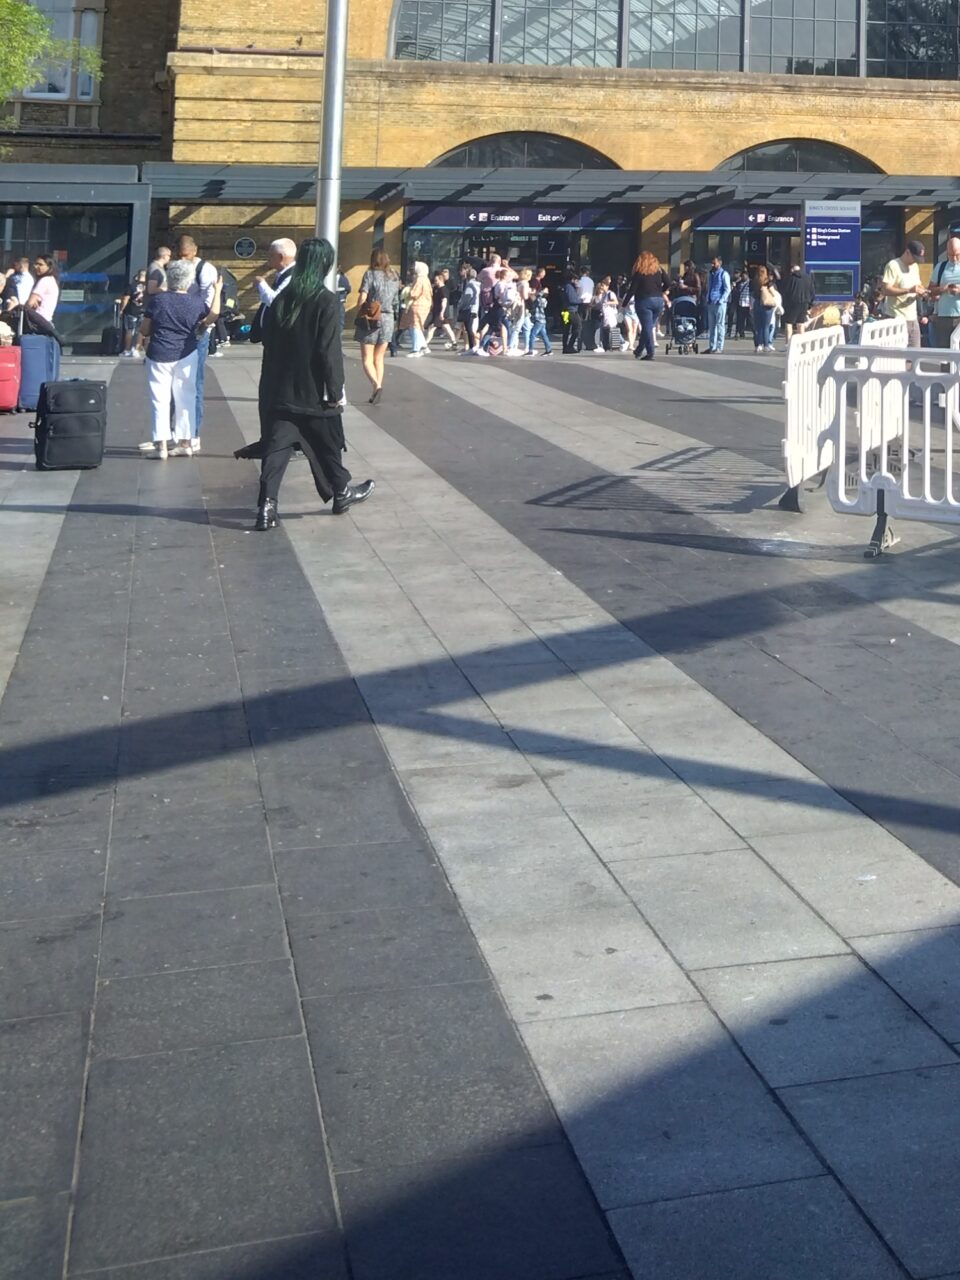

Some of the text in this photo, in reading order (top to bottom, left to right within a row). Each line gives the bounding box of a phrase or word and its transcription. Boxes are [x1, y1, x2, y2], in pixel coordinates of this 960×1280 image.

[490, 214, 520, 222] Entrance
[537, 213, 567, 223] Exit only
[414, 240, 422, 250] 8
[548, 241, 555, 251] 7
[751, 241, 758, 251] 6
